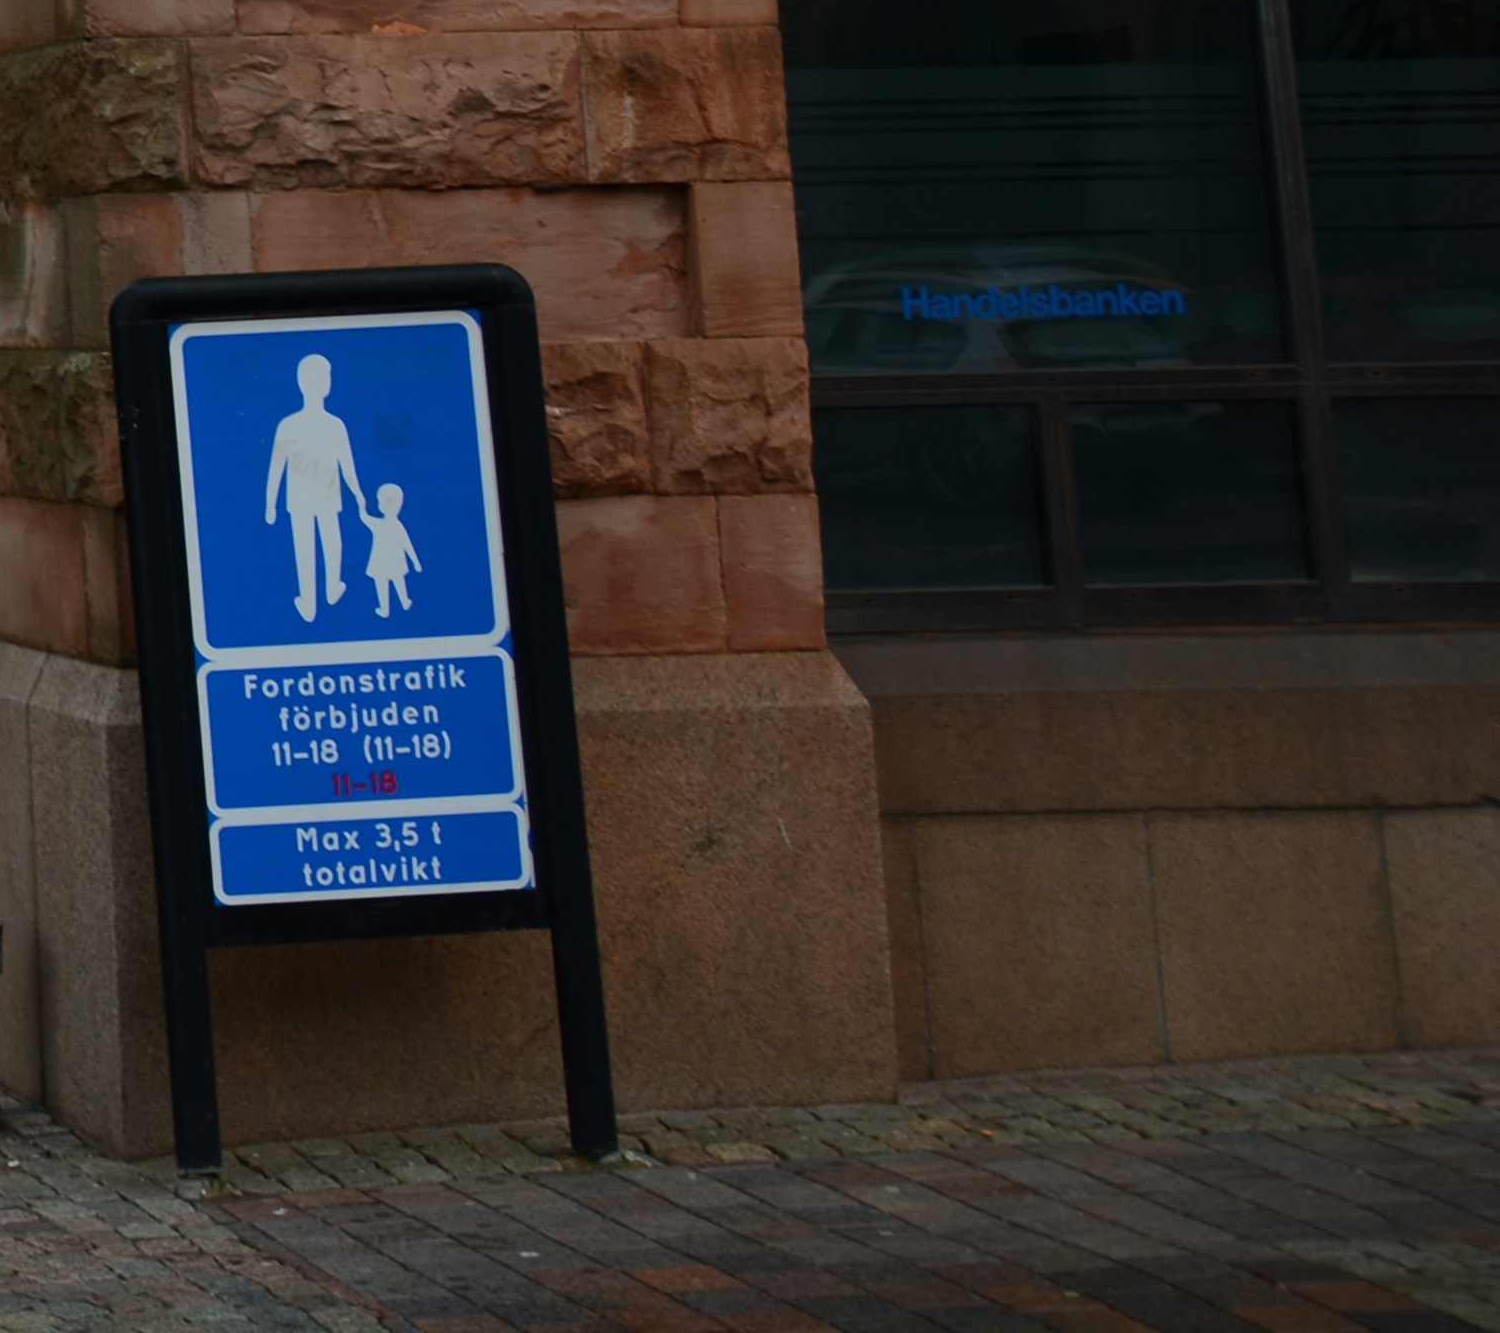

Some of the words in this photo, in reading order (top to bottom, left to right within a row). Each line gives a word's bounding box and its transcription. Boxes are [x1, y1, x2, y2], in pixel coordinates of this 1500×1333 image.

[901, 282, 1187, 320] Handelsbanken
[243, 663, 467, 700] Fordonstrafik
[279, 701, 440, 734] förbjuden
[271, 739, 339, 767] 11-18
[362, 729, 453, 765] (11-18)
[331, 771, 399, 797] 11-18
[297, 825, 361, 852] Max
[374, 822, 421, 853] 3,5
[431, 821, 443, 845] t
[303, 856, 443, 886] totalvikt
